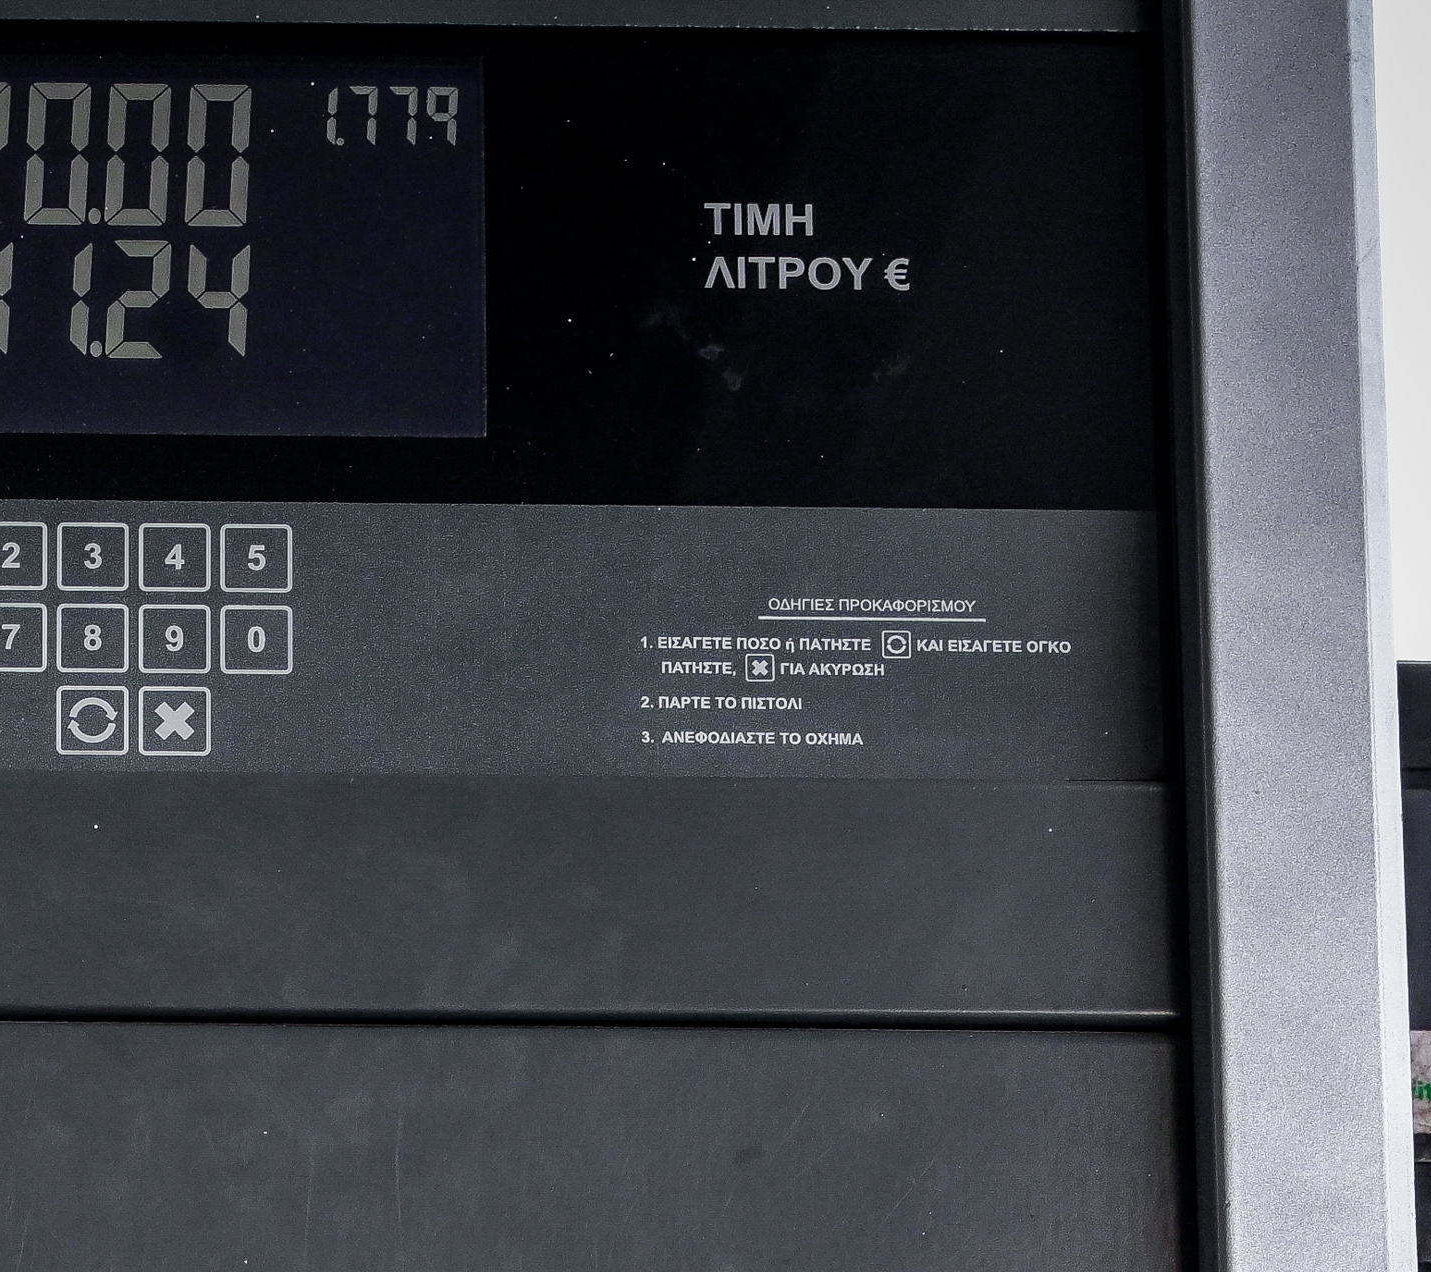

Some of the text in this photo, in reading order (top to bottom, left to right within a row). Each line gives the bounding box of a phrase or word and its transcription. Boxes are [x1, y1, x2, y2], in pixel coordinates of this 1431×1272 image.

[326, 85, 459, 147] 1.779
[704, 202, 815, 236] ΤΙΜΗ
[704, 256, 911, 291] ΛΙΤΡΟΥ €
[2, 542, 21, 569] 2
[83, 543, 102, 570] 3
[165, 544, 184, 570] 4
[247, 545, 266, 571] 5
[768, 598, 834, 611] ΟΔΗΓΙΕΣ
[2, 624, 20, 650] 7
[83, 624, 102, 651] 8
[165, 625, 184, 652] 9
[248, 626, 266, 653] 0
[640, 636, 653, 649] 1.
[657, 636, 732, 649] ΕΙΣΑΓΕΤΕ
[736, 637, 782, 650] ΠΟΣΟ
[799, 638, 872, 651] ΠΑΤΗΣΤΕ
[917, 639, 944, 652] ΚΑΙ
[948, 640, 1023, 652] ΕΙΣΑΓΕΤΕ
[1026, 640, 1072, 654] ΟΓΚΟ
[661, 661, 885, 677] ΠΑΤΗΣΤΕ, ΓΙΑ ΑΚΥΡΩΣΗ
[640, 696, 803, 710] 2. ΠΑΡΤΕ ΤΟ ΠΙΣΤΟΛΙ
[641, 731, 864, 745] 3. ΑΝΕΦΟΔΙΑΣΤΕ ΤΟ ΟΧΗΜΑ
